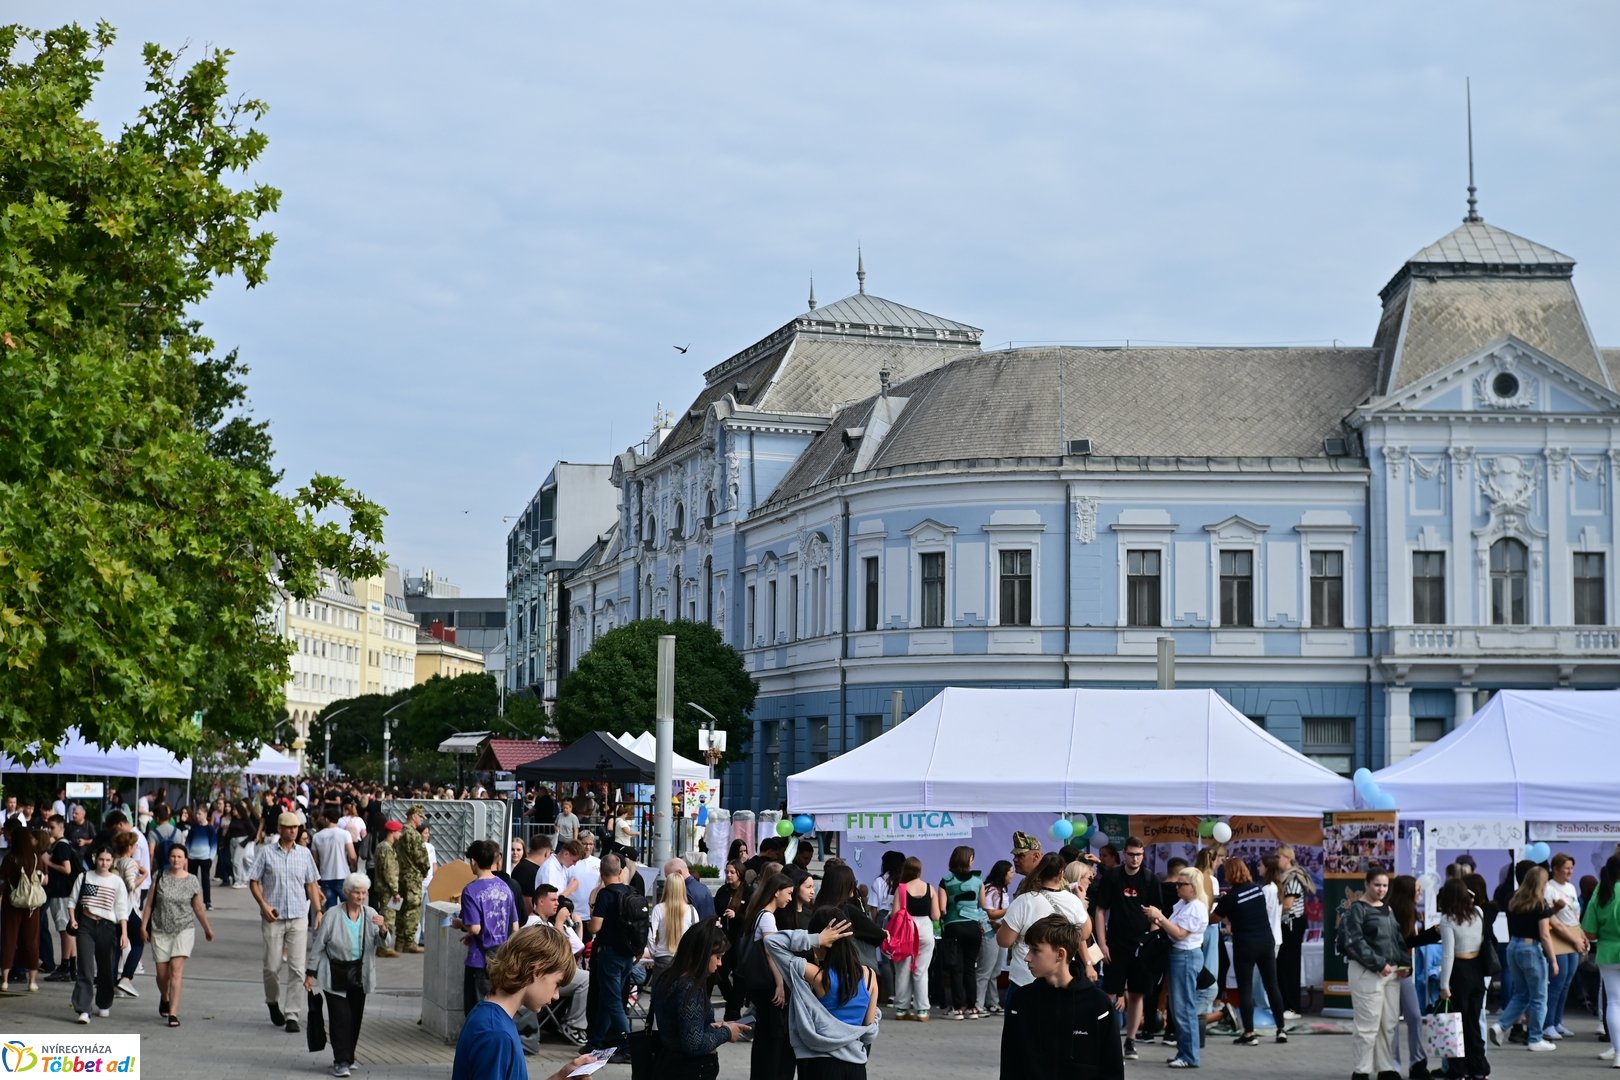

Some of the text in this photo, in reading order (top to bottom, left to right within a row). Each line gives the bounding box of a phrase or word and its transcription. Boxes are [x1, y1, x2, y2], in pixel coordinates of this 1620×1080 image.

[848, 812, 954, 829] FITT UTCA
[1246, 823, 1265, 833] Kar
